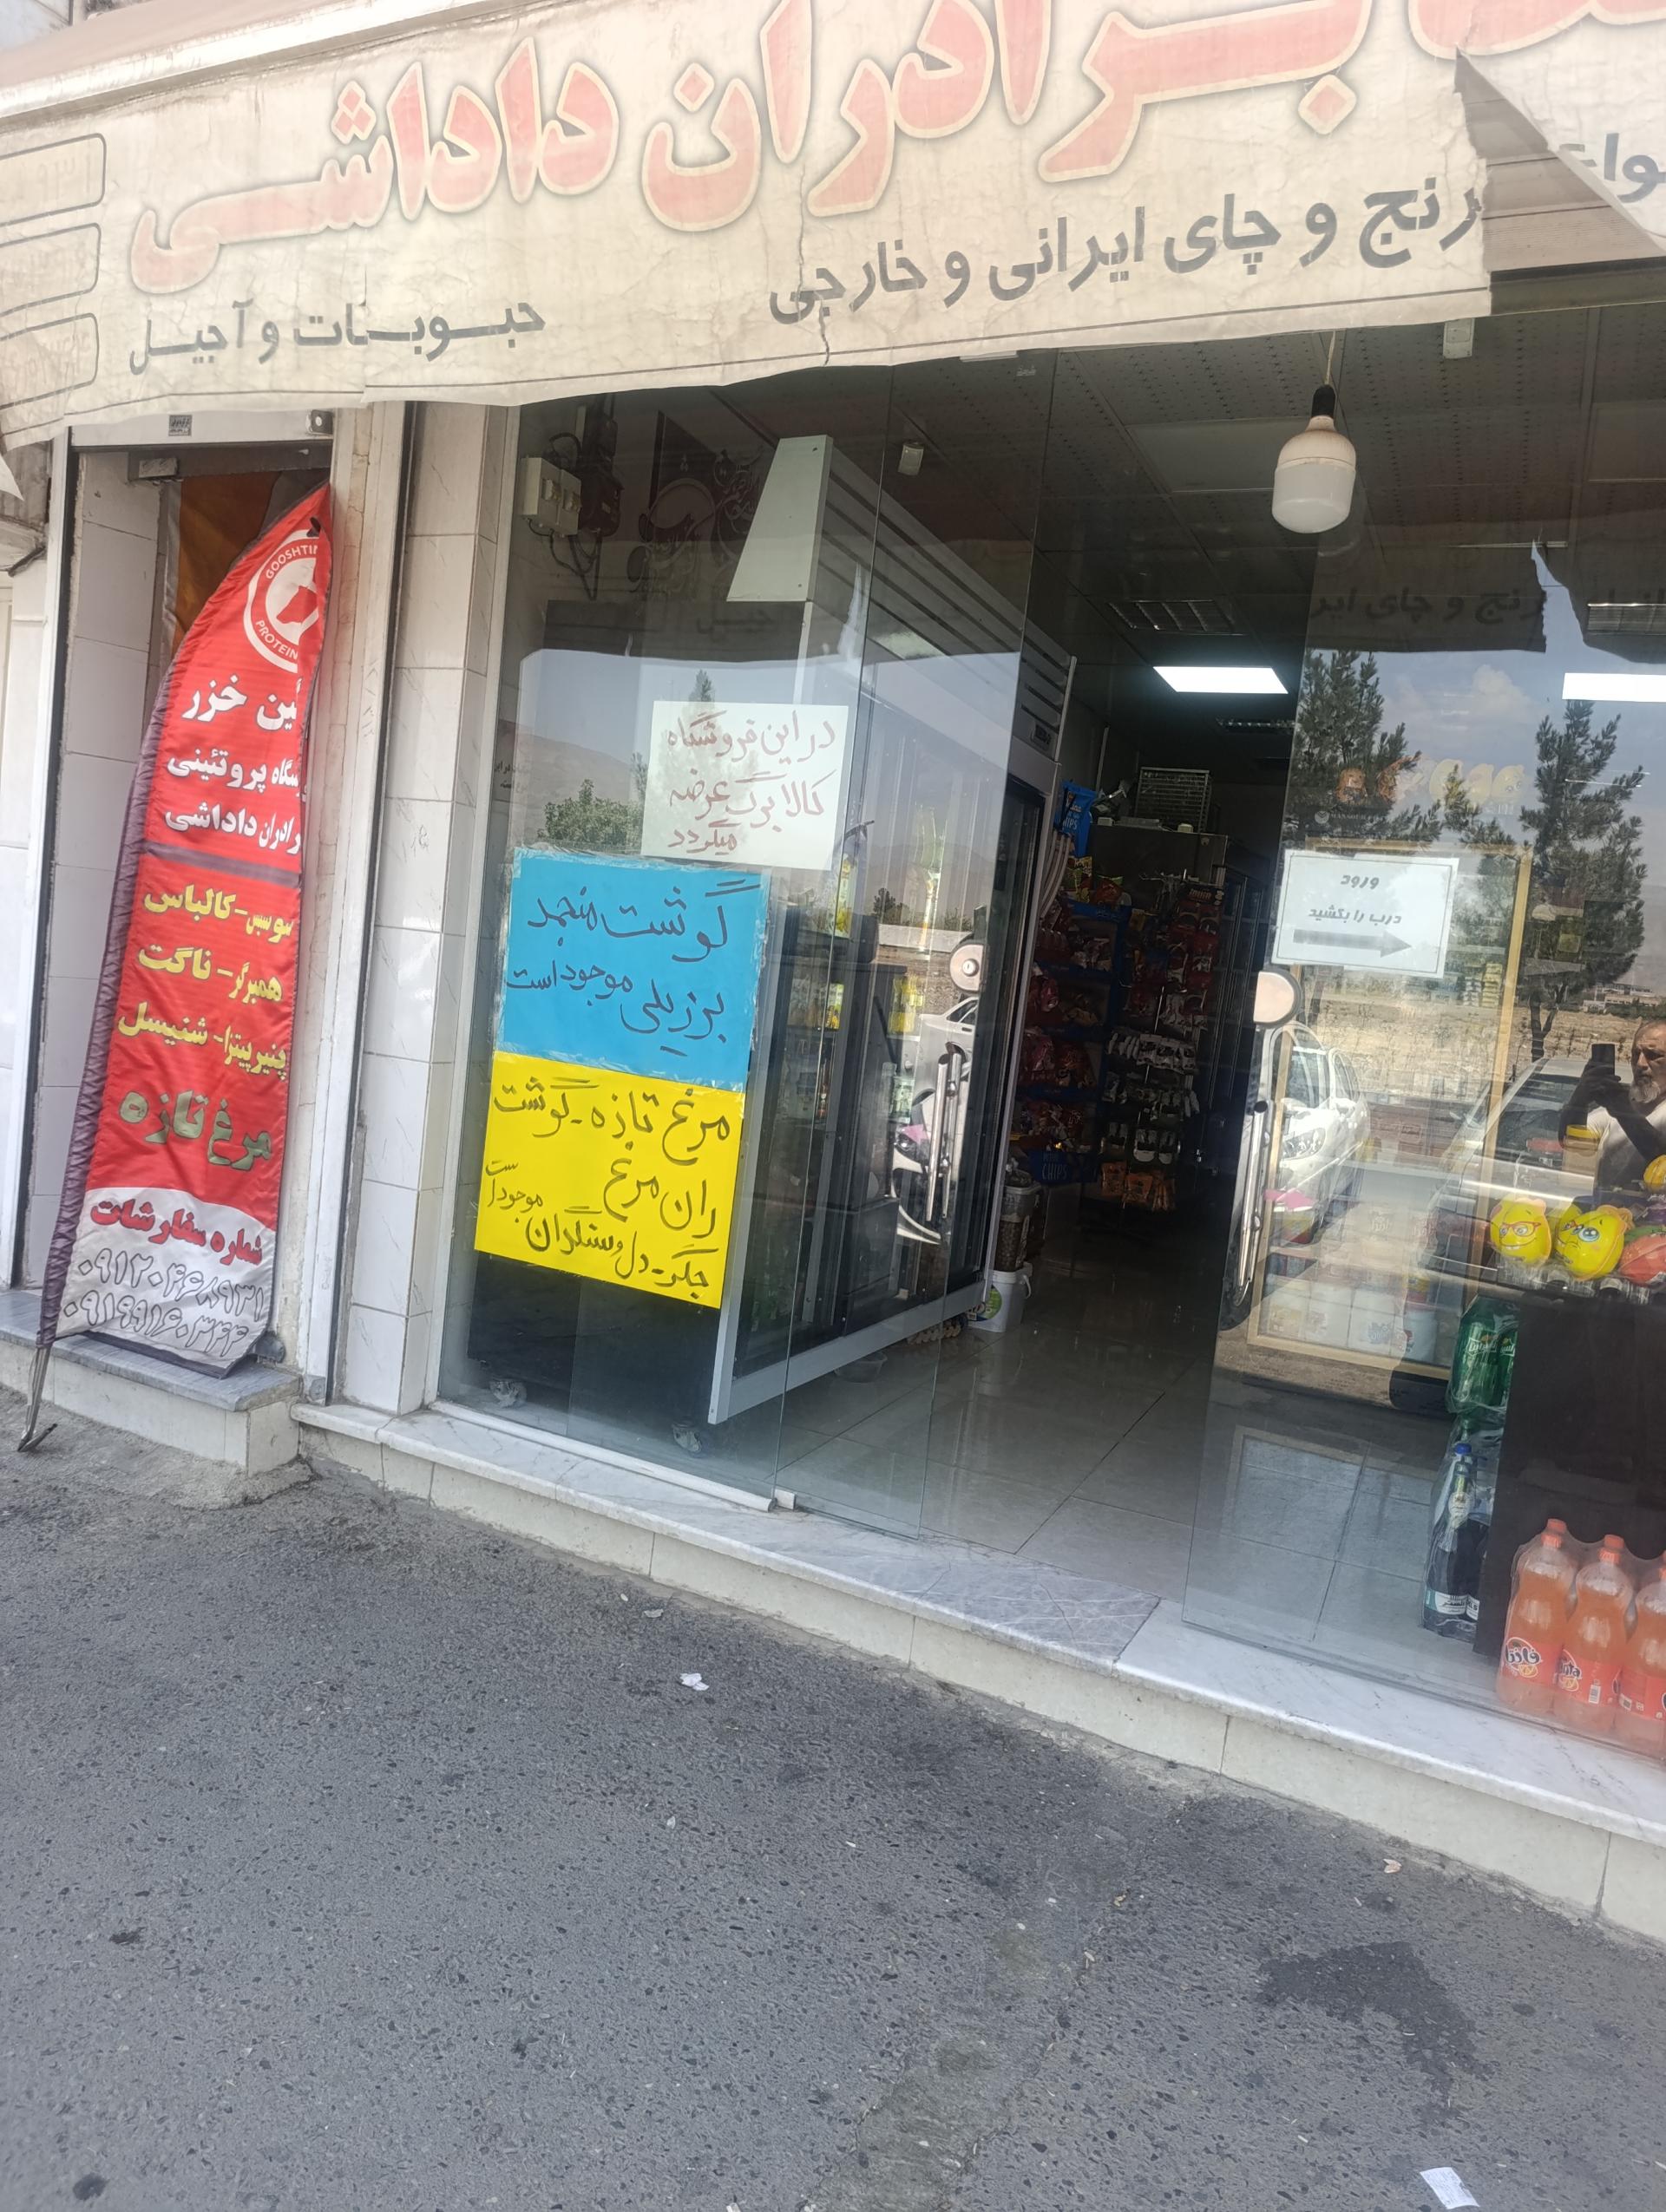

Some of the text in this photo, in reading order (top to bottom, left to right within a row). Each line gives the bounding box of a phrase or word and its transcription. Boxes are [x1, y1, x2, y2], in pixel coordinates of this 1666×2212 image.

[128, 36, 620, 295] داداشی
[770, 177, 1482, 324] رنج و چای ایرانی و خارجی
[129, 298, 253, 375] آجیل
[258, 320, 280, 364] و
[293, 301, 546, 362] حبوبات
[256, 619, 298, 660] PROTEIN
[181, 675, 247, 722] خزر
[667, 710, 836, 765] در این فروشگاه
[165, 802, 258, 836] داداشی
[1341, 874, 1380, 890] ورود
[527, 879, 761, 962] گوشت منجمد
[1308, 904, 1403, 926] درب را بکشید
[138, 944, 212, 980] ناگت
[506, 959, 558, 990] است
[561, 964, 634, 1006] موجود
[118, 1001, 208, 1046] شنیسل
[118, 1090, 272, 1171] مرغ تازه
[493, 1077, 600, 1138] گوشت
[591, 1090, 659, 1138] تازه
[662, 1089, 731, 1166] مرغ
[603, 1141, 717, 1239] ران مرغ
[90, 1198, 207, 1247] سفارشات
